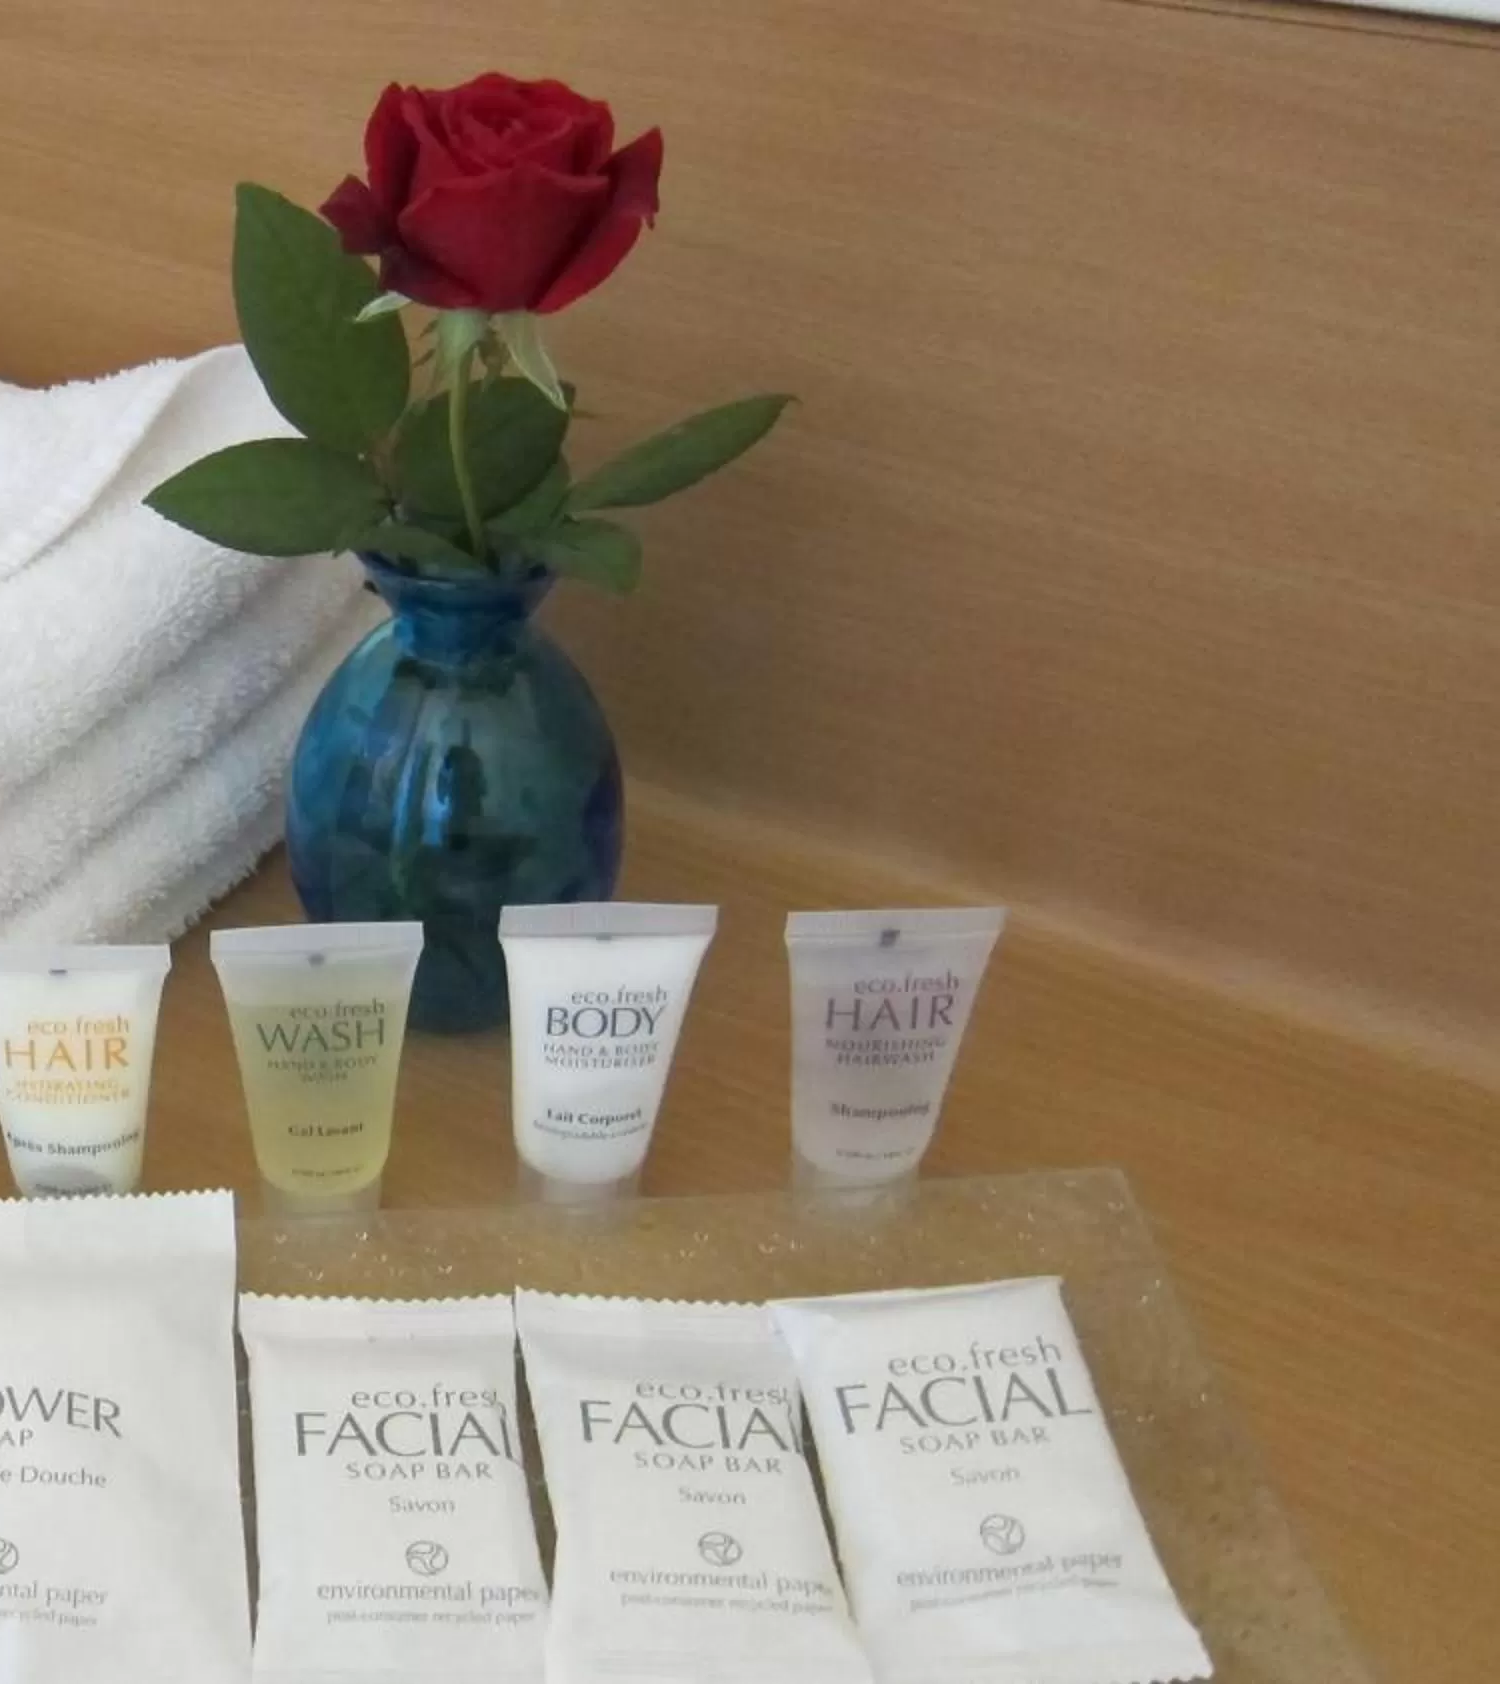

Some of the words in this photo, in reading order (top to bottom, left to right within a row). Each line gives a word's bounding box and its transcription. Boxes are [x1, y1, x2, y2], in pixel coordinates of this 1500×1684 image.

[571, 984, 668, 1005] eco.fresh
[546, 1006, 667, 1038] BODY
[825, 994, 955, 1031] HAIR
[256, 1018, 384, 1053] WASH
[4, 1037, 130, 1072] HAIR
[543, 1042, 594, 1056] HAND
[598, 1044, 609, 1056] &
[546, 1107, 573, 1125] Lait
[887, 1336, 1062, 1376] eco.fresh
[350, 1382, 499, 1409] eco.fres
[635, 1382, 790, 1406] eco.fres
[835, 1367, 1093, 1434] FACIAL
[900, 1431, 981, 1456] SOAP
[990, 1425, 1052, 1447] BAR
[345, 1461, 425, 1481] SOAP
[436, 1461, 494, 1481] BAR
[633, 1450, 715, 1472] SOAP
[725, 1454, 784, 1476] BAR
[19, 1464, 108, 1489] Douche
[950, 1465, 1022, 1487] Savon
[388, 1495, 457, 1515] Savon
[677, 1485, 747, 1505] Savon
[609, 1568, 769, 1590] environmental
[896, 1555, 1055, 1586] environmental
[45, 1586, 109, 1610] paper
[316, 1579, 473, 1602] environmental
